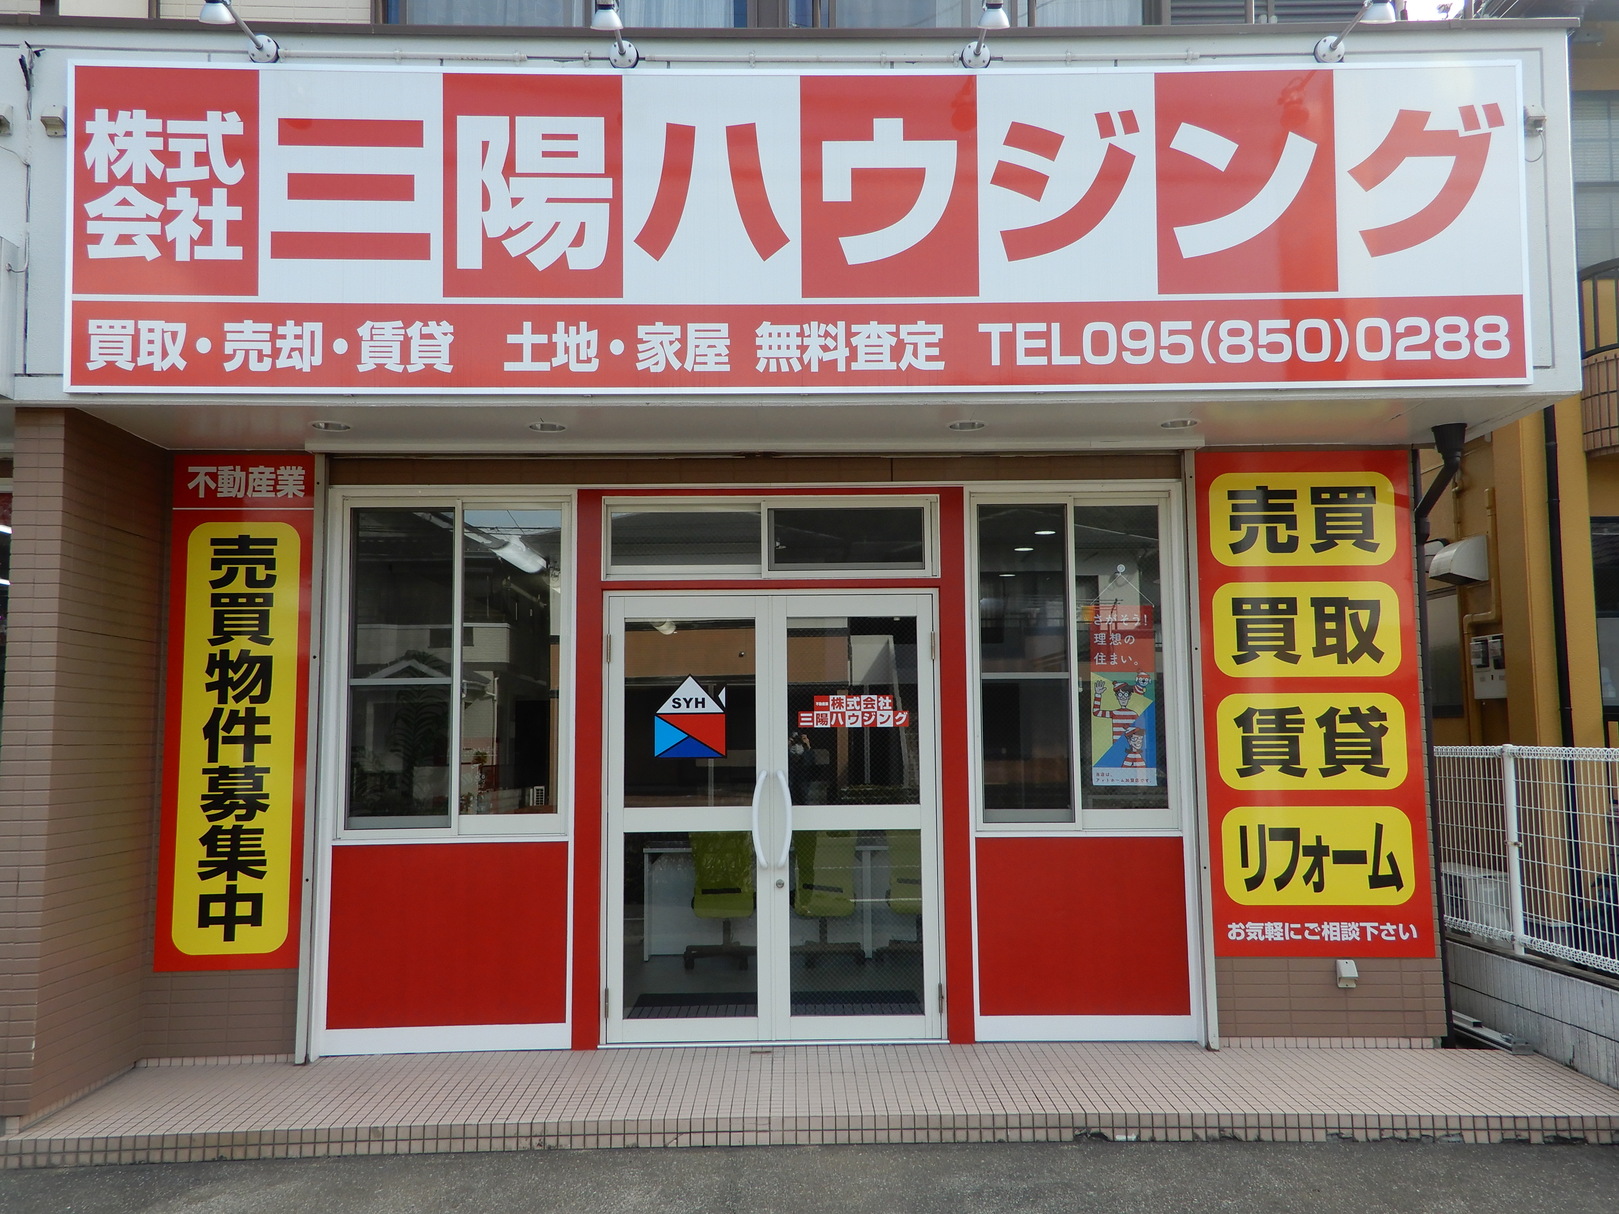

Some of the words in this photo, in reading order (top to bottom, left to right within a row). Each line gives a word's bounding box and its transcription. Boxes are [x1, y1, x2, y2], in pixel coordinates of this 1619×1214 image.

[84, 109, 245, 185] 株式
[271, 102, 1505, 271] 三陽ハウジング
[84, 187, 243, 261] 会社
[86, 319, 454, 373] 買取・売却・賃貸
[504, 320, 731, 373] 土地・家屋
[755, 320, 945, 373] 無料査定
[978, 314, 1511, 368] TEL095(850)0288
[187, 465, 306, 499] 不動産業
[1227, 485, 1380, 556] 売買
[1094, 633, 1135, 645] 理想の
[1094, 652, 1138, 665] 住まい。
[1231, 596, 1384, 665] 買取
[672, 697, 706, 709] SYH
[800, 711, 908, 726] 三陽ハウジング
[831, 696, 892, 710] 株式会社
[197, 534, 278, 942] 売買物件募集中
[1233, 705, 1390, 778] 賃貸
[1239, 822, 1404, 893] リフォーム
[1227, 920, 1418, 943] お気軽にご相談下さい
